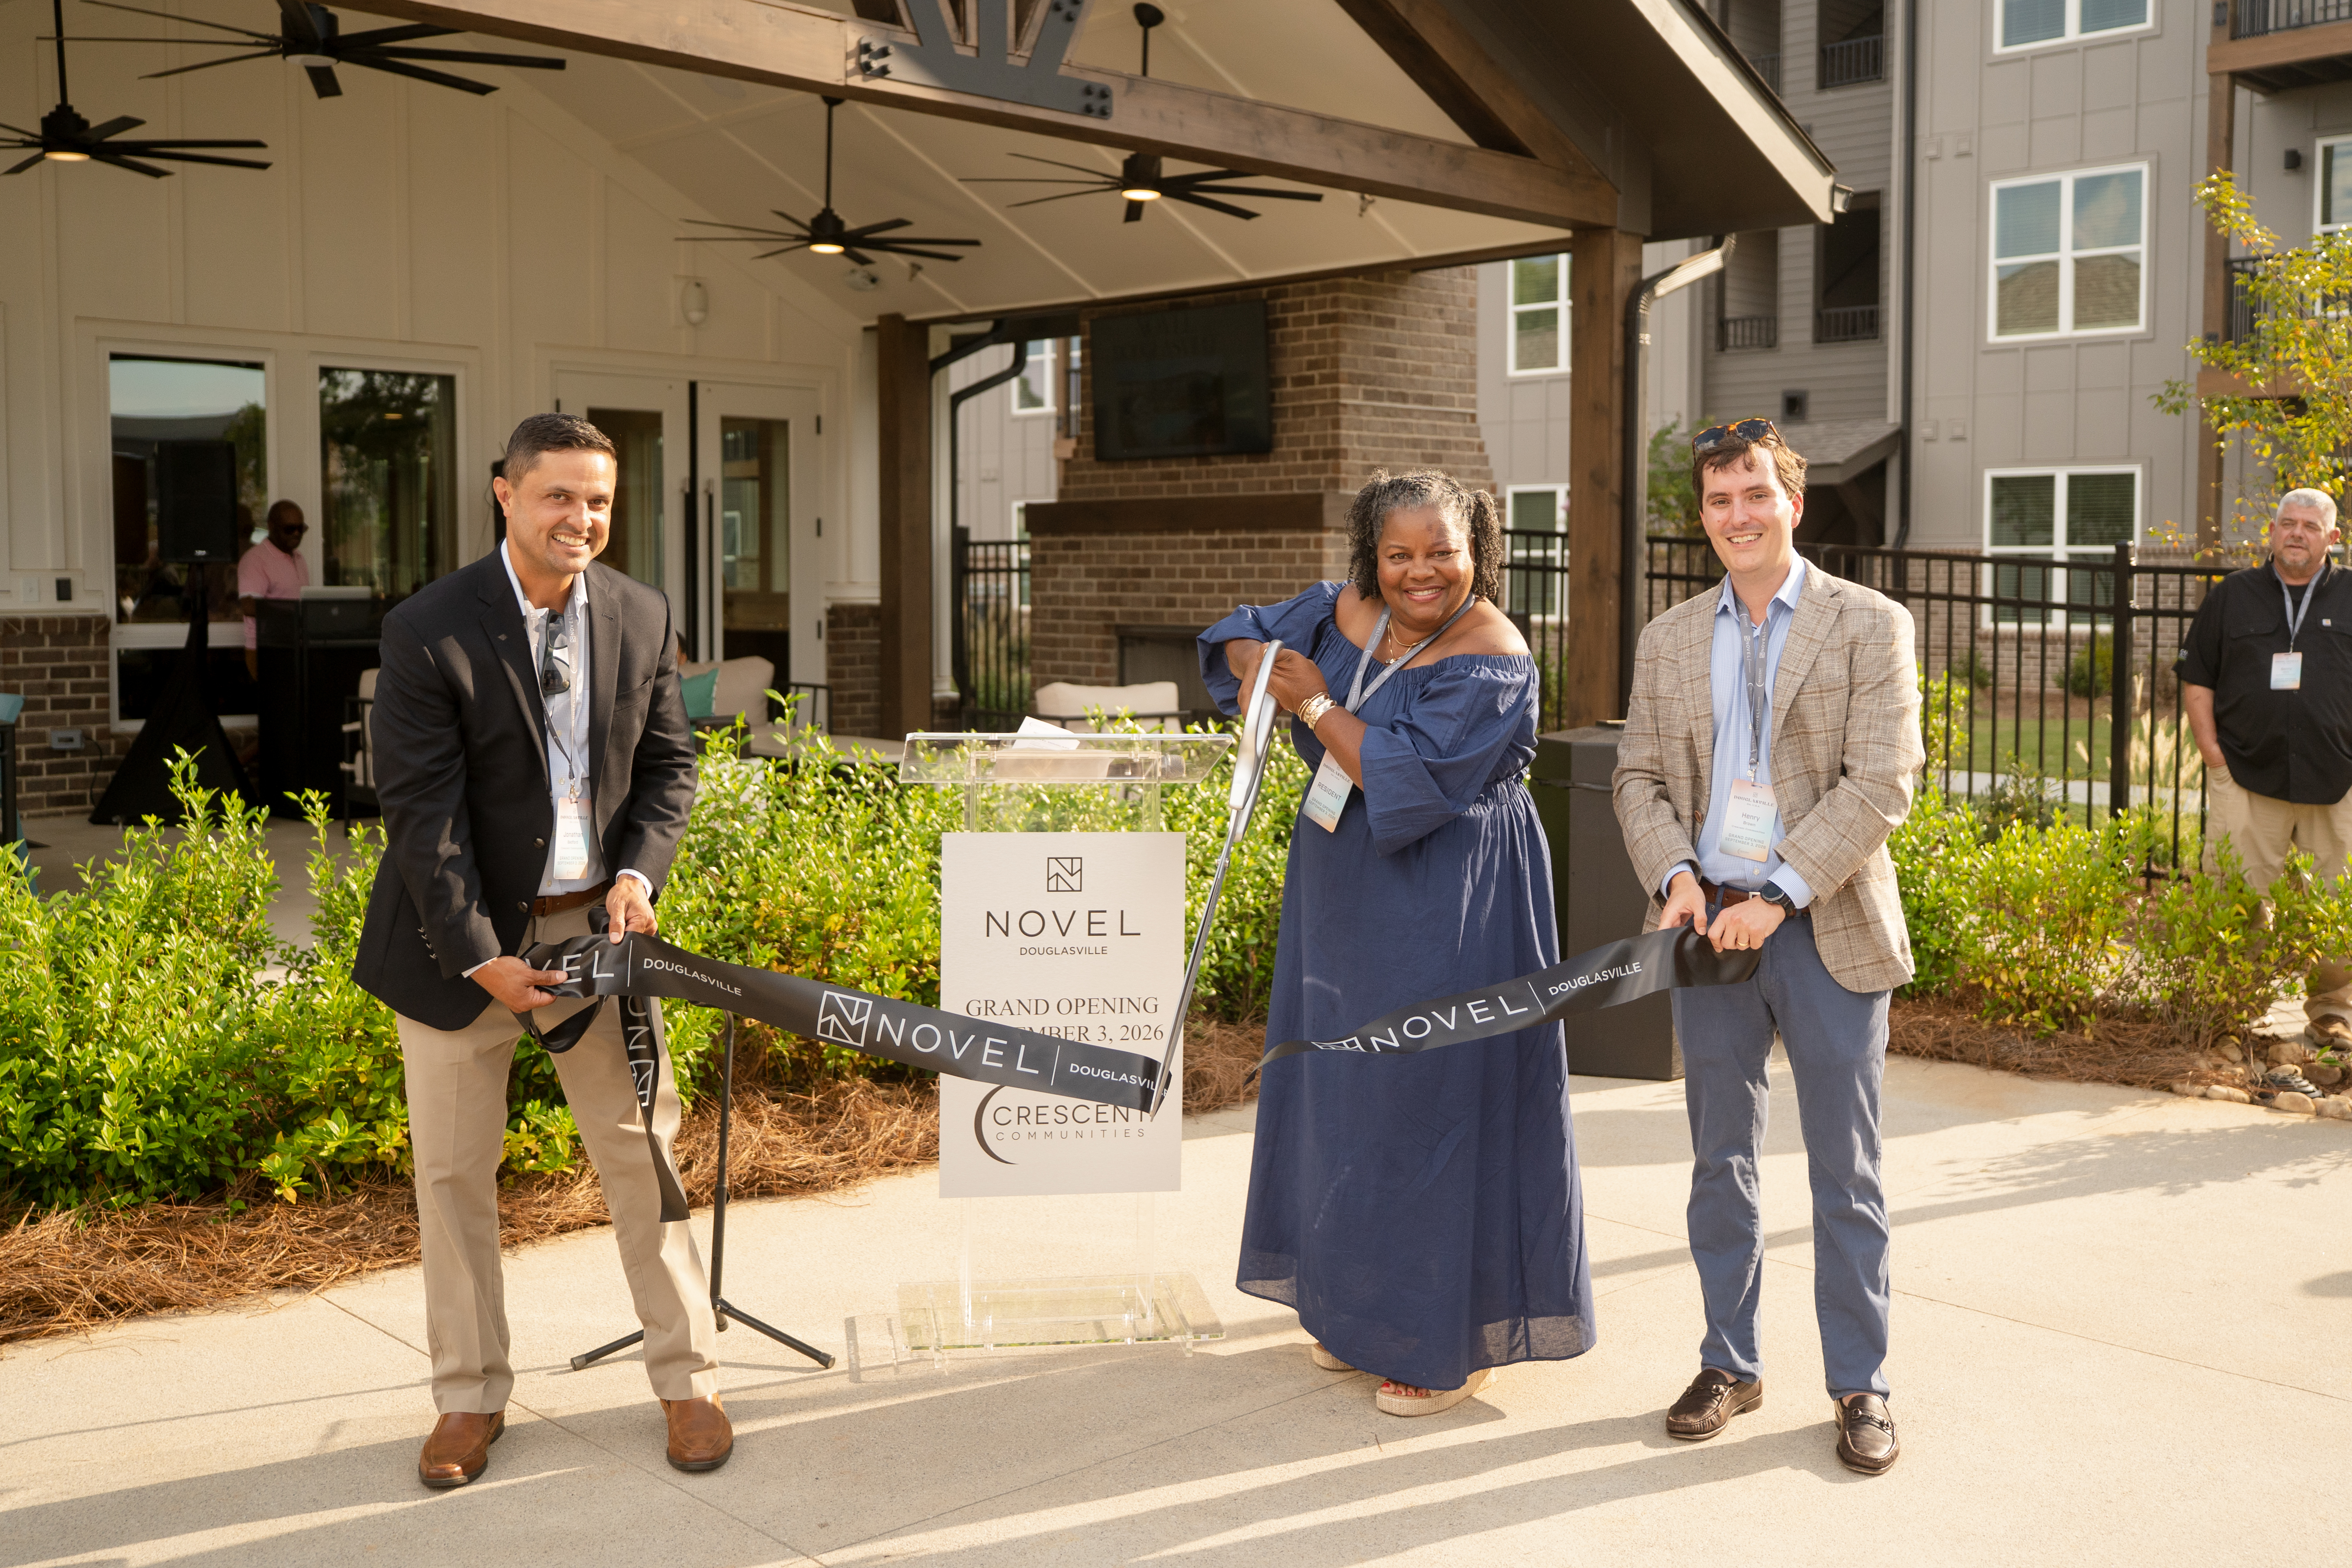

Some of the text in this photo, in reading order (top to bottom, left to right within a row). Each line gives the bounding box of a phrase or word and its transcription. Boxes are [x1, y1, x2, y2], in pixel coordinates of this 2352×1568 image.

[1376, 619, 1384, 633] NOVEL
[1389, 660, 1404, 673] NOVEL
[1323, 763, 1351, 783] DOUGLASVILLE
[1317, 782, 1342, 801] RESIDENT
[1308, 800, 1325, 813] SEPTEMBER
[1312, 797, 1336, 815] GRAND OPENING
[1734, 795, 1775, 807] DOUGLASVILLE
[1742, 812, 1760, 822] Henry
[1725, 837, 1749, 845] SEPTEMBER
[986, 909, 1141, 937] NOVEL
[1020, 946, 1108, 956] DOUGLASVILLE
[643, 958, 742, 997] DOUGLASVILLE
[966, 997, 1159, 1017] GRAND OPENING
[1370, 961, 1643, 1052] NOVEL DOUGLASVILLE
[1097, 1025, 1113, 1044] 3,
[1119, 1024, 1164, 1041] 2026
[876, 1013, 1039, 1074] NOVEL
[996, 1129, 1144, 1141] COMMUNITIES
